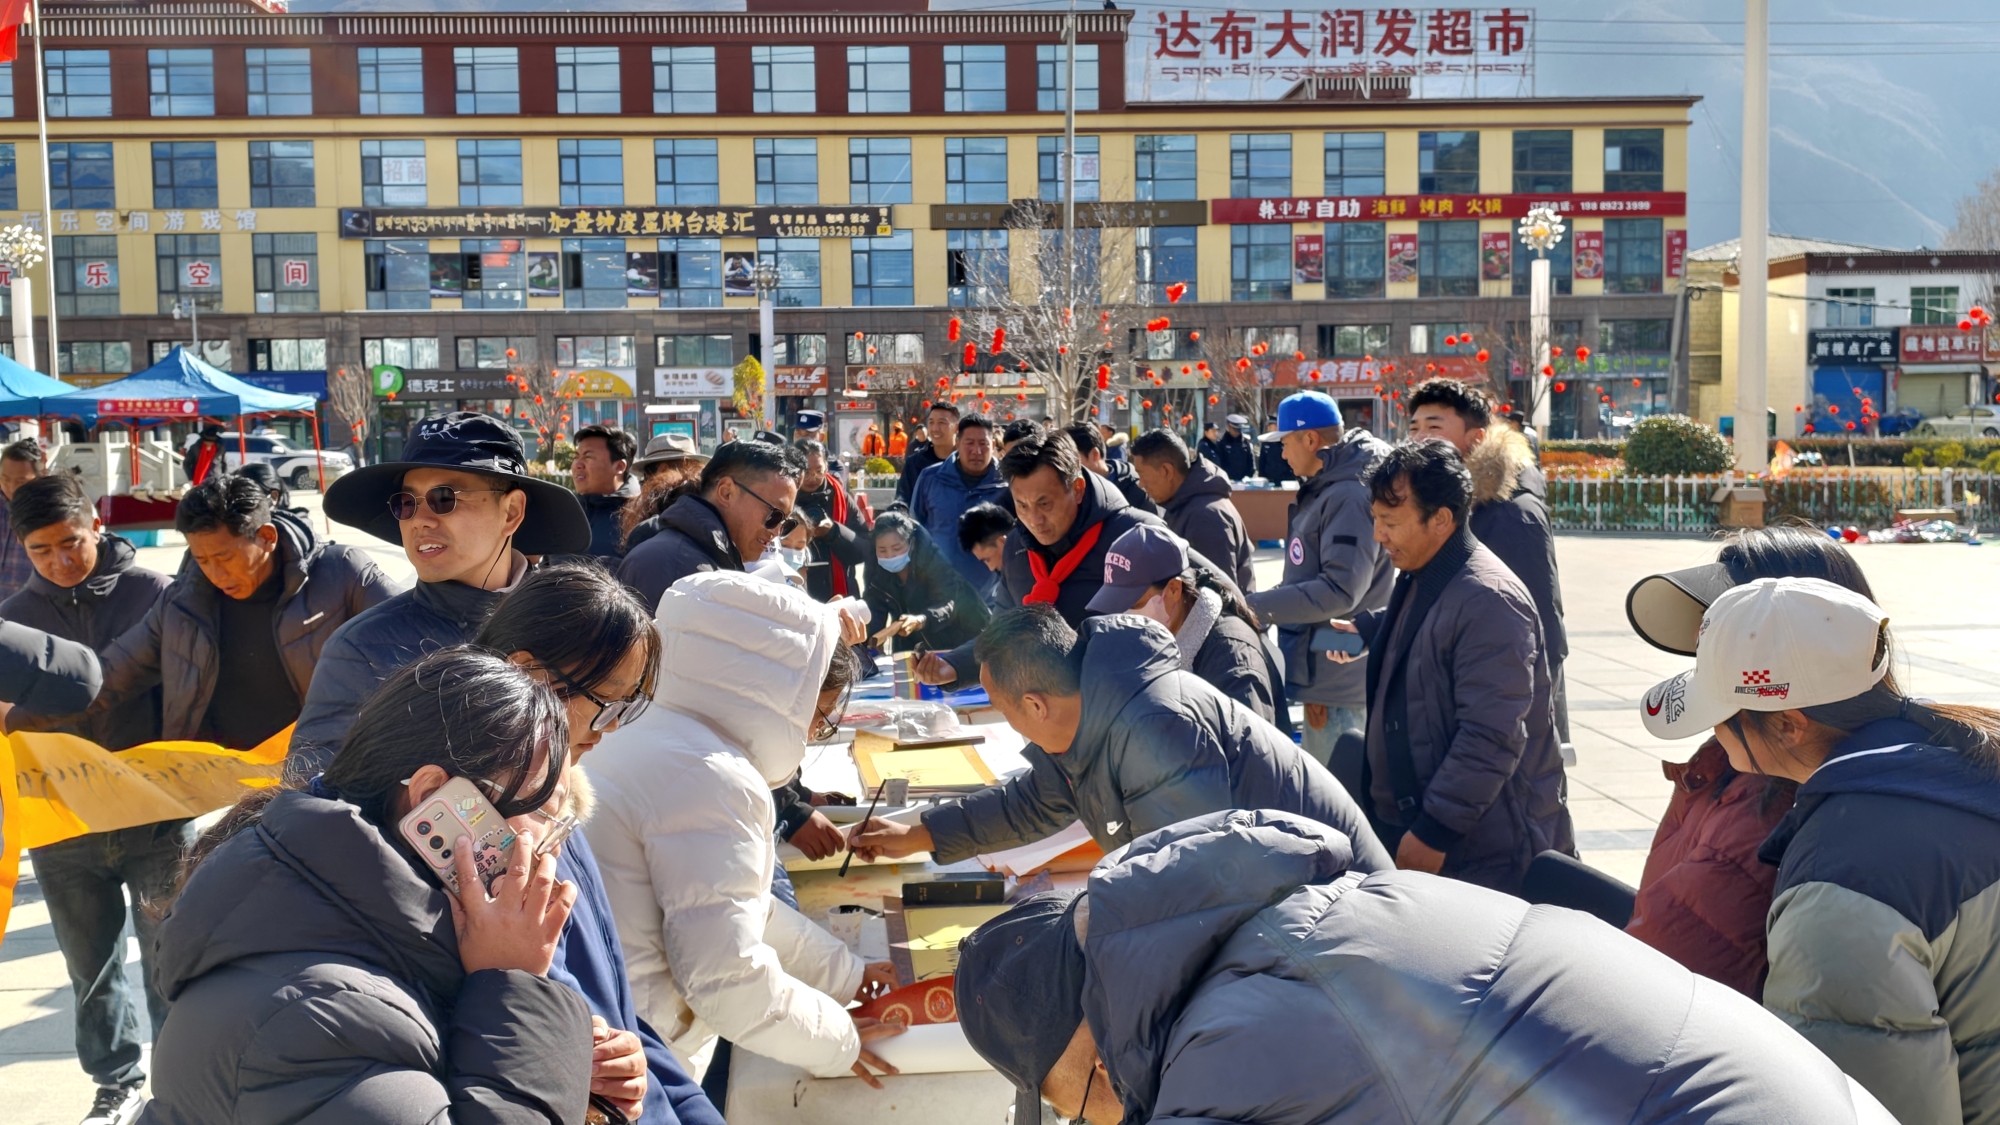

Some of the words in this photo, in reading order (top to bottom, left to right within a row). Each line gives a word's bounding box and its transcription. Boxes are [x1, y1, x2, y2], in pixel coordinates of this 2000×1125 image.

[1154, 8, 1530, 60] 达布大润发超市
[383, 158, 425, 182] 招商
[1419, 199, 1453, 214] 烤肉
[1466, 198, 1503, 214] 火锅
[21, 208, 258, 232] 玩乐空间游戏馆
[786, 225, 866, 237] 19108932999
[1816, 341, 1891, 356] 新视点广告
[407, 379, 455, 393] 德克士
